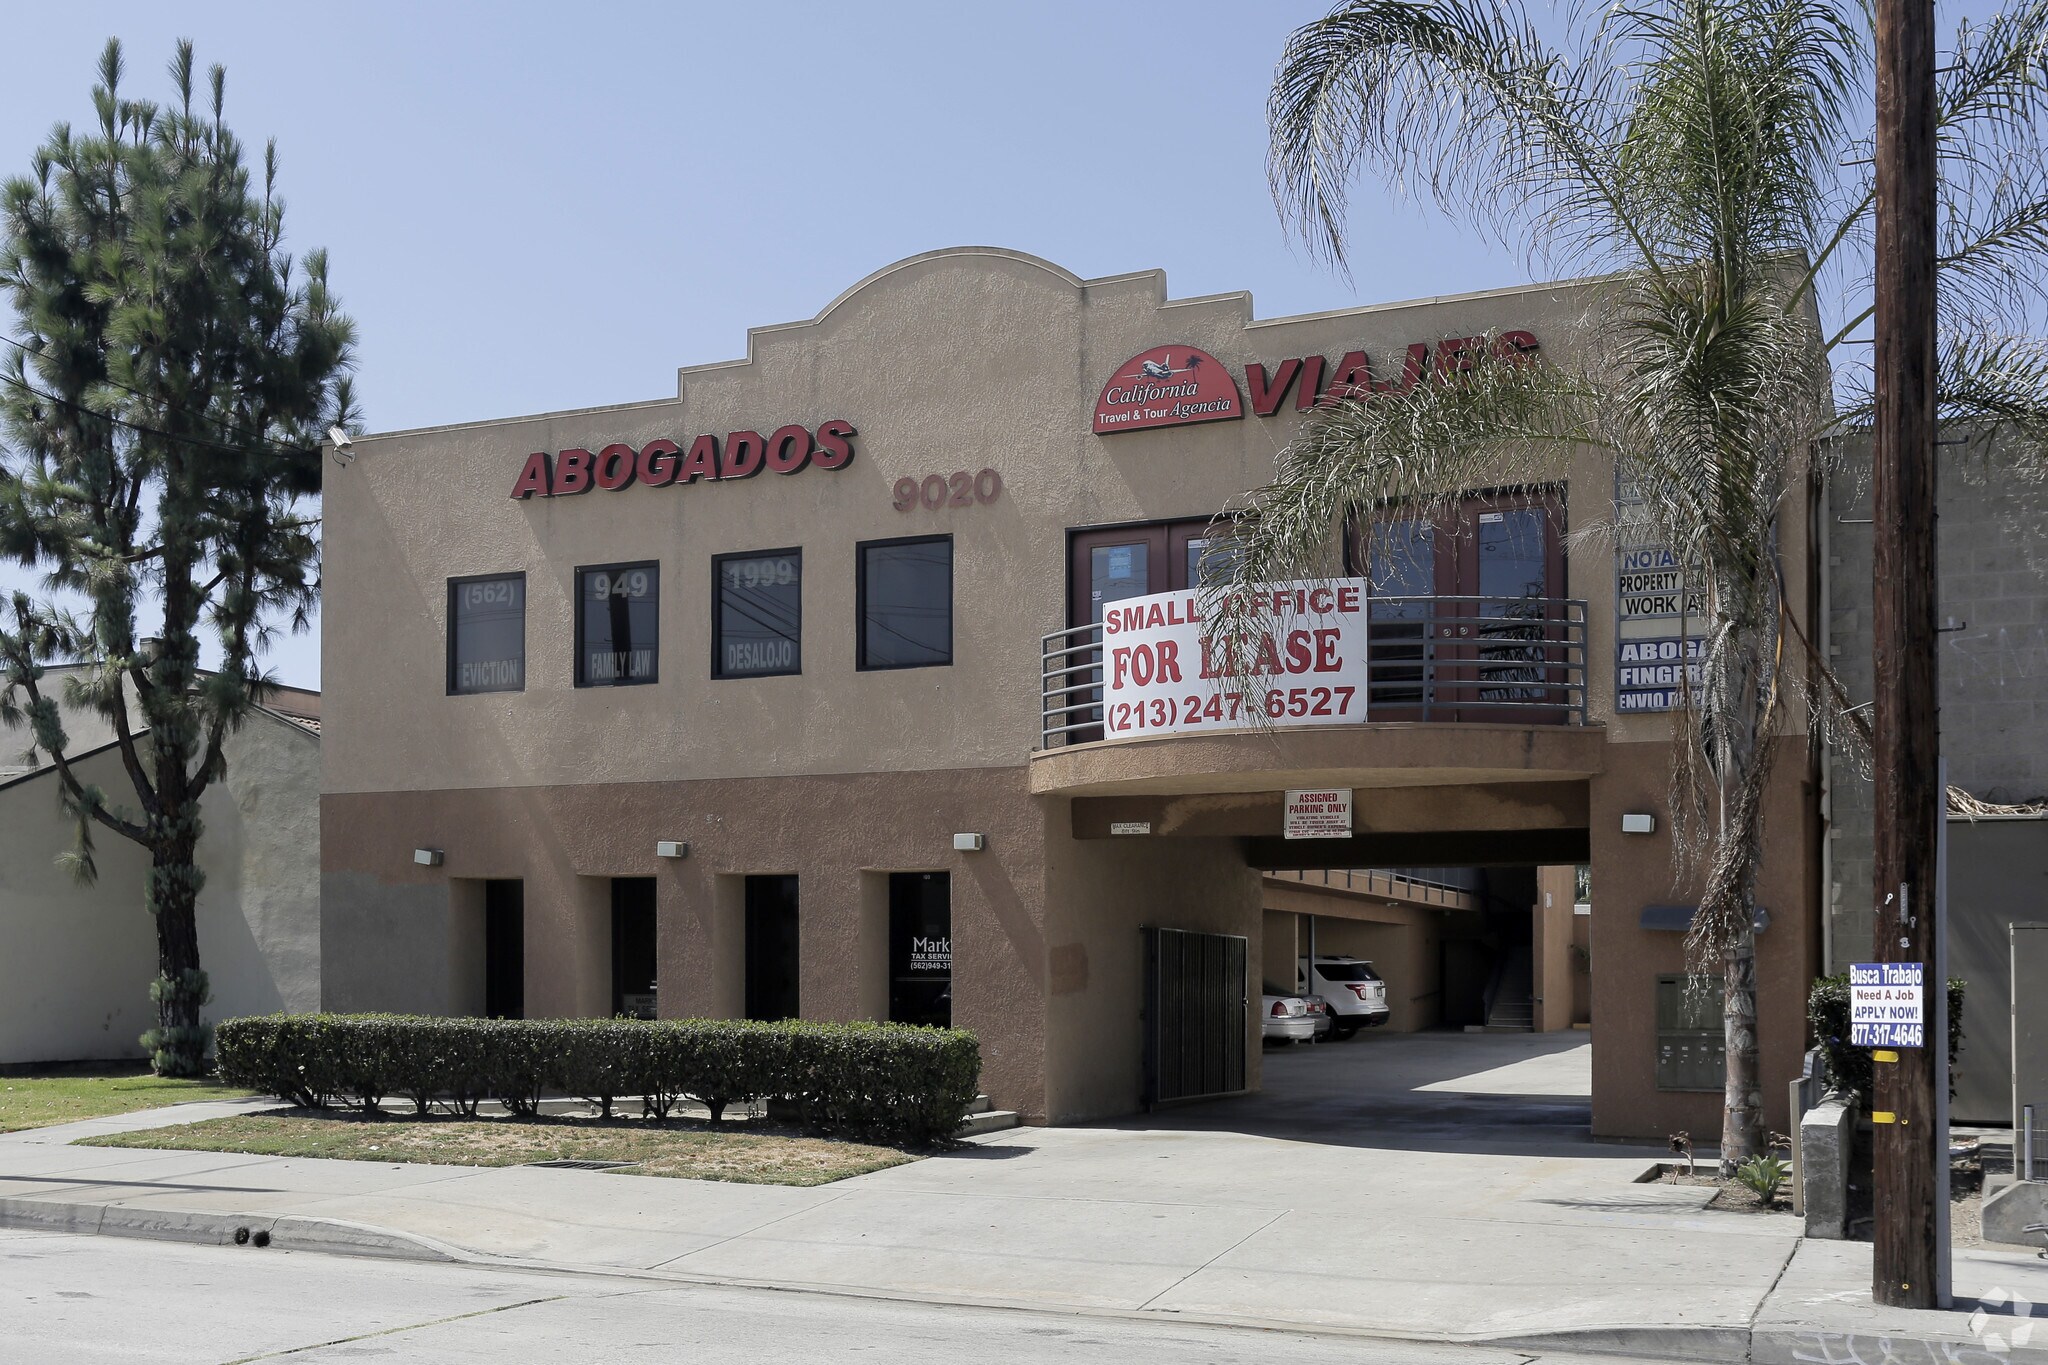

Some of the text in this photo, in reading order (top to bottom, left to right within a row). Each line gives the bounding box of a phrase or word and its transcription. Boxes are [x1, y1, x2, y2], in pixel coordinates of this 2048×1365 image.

[1106, 380, 1198, 406] California
[1099, 397, 1232, 424] Travel & Tour Agencia
[510, 419, 857, 500] ABOGADOS
[893, 468, 1000, 512] 9020
[1624, 549, 1680, 569] NOTA
[594, 571, 648, 600] 949
[729, 559, 792, 589] 1999
[1620, 573, 1678, 592] PROPERTY
[464, 581, 515, 610] (562)
[1625, 596, 1678, 614] WORK
[1106, 598, 1205, 635] SMALL
[591, 650, 651, 679] FAMILY LAW
[728, 640, 792, 670] DESALOJO
[1112, 628, 1343, 690] FOR LEASE
[462, 659, 518, 687] EVICTION
[1620, 692, 1664, 709] ENVIO
[1289, 803, 1347, 814] PARKING ONLY
[1299, 793, 1338, 803] ASSIGNED
[913, 937, 951, 952] Mark
[1850, 964, 1921, 986] Busca Trabajo
[1856, 989, 1915, 1000] Need A Job
[1855, 1006, 1918, 1019] APPLY NOW!
[1851, 1023, 1922, 1046] 877-317-4646
